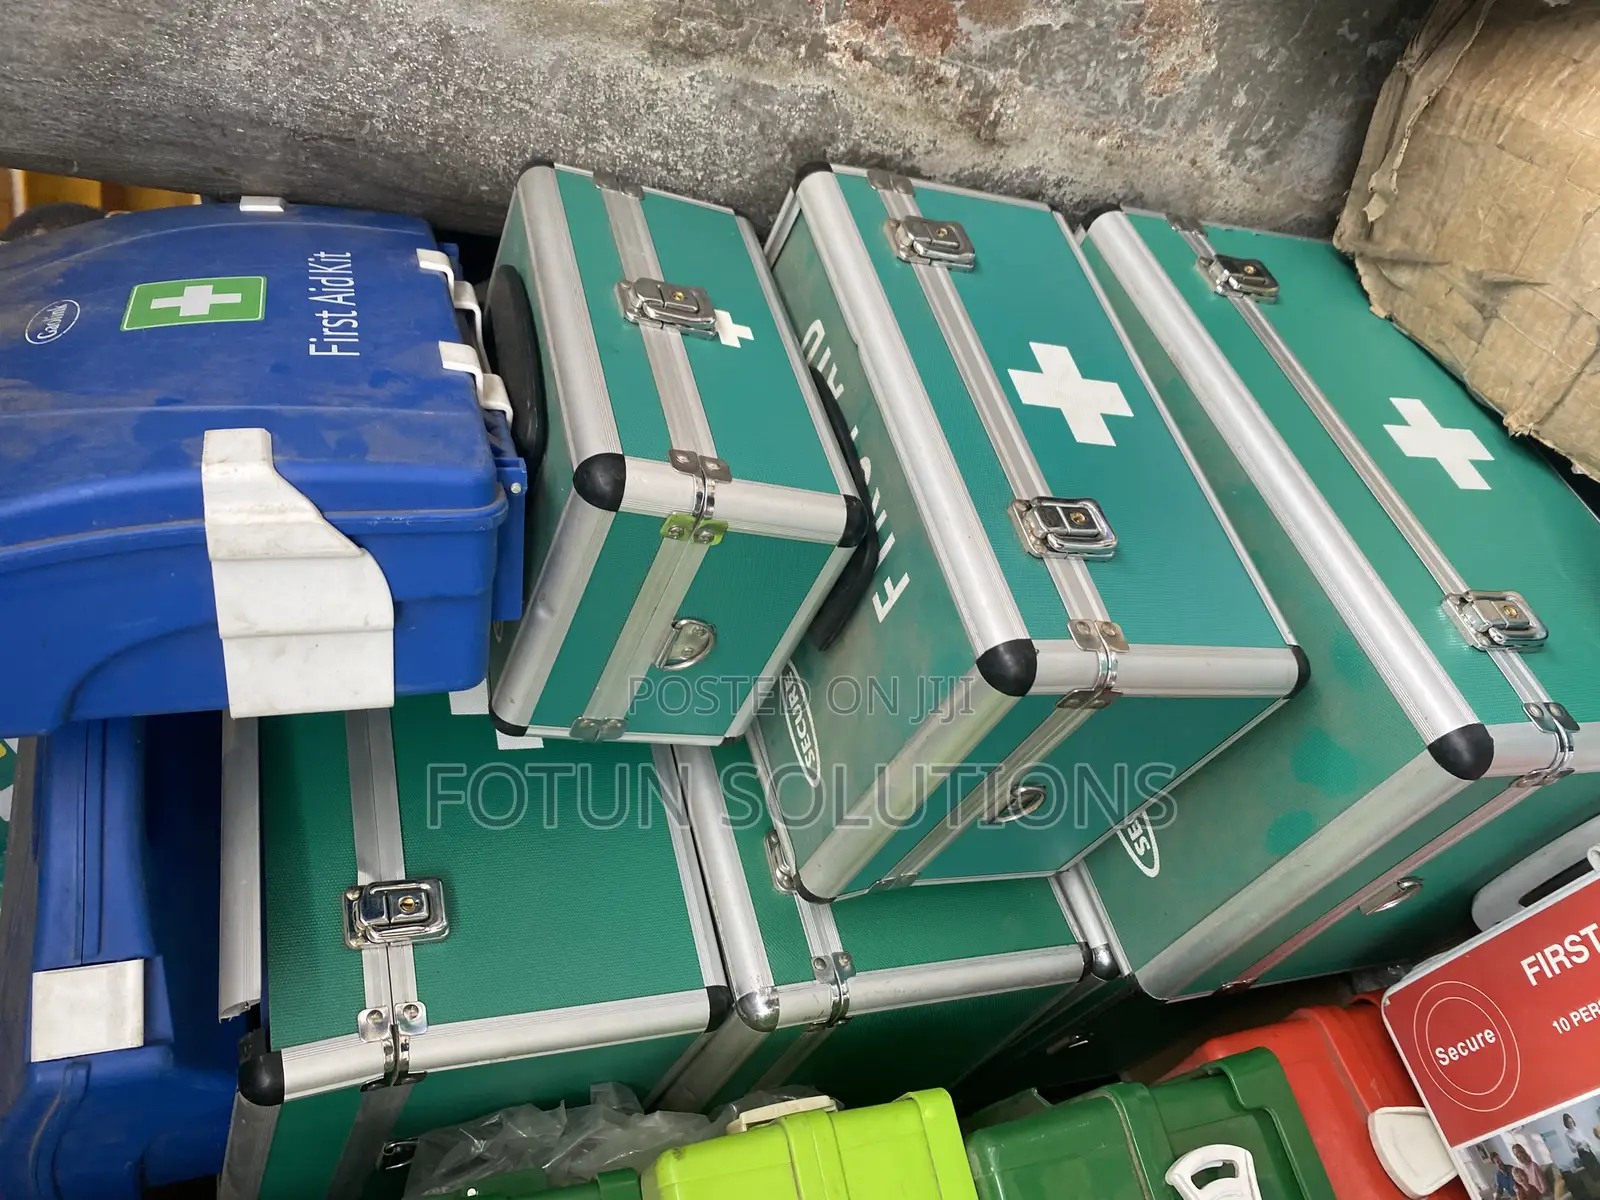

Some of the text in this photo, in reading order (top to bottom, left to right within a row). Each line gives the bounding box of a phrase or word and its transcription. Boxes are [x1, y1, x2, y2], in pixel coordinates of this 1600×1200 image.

[308, 310, 360, 356] First
[783, 671, 816, 769] SECURE
[1520, 923, 1600, 987] FIRST
[1435, 1029, 1496, 1066] Secure
[1552, 1016, 1571, 1034] 10
